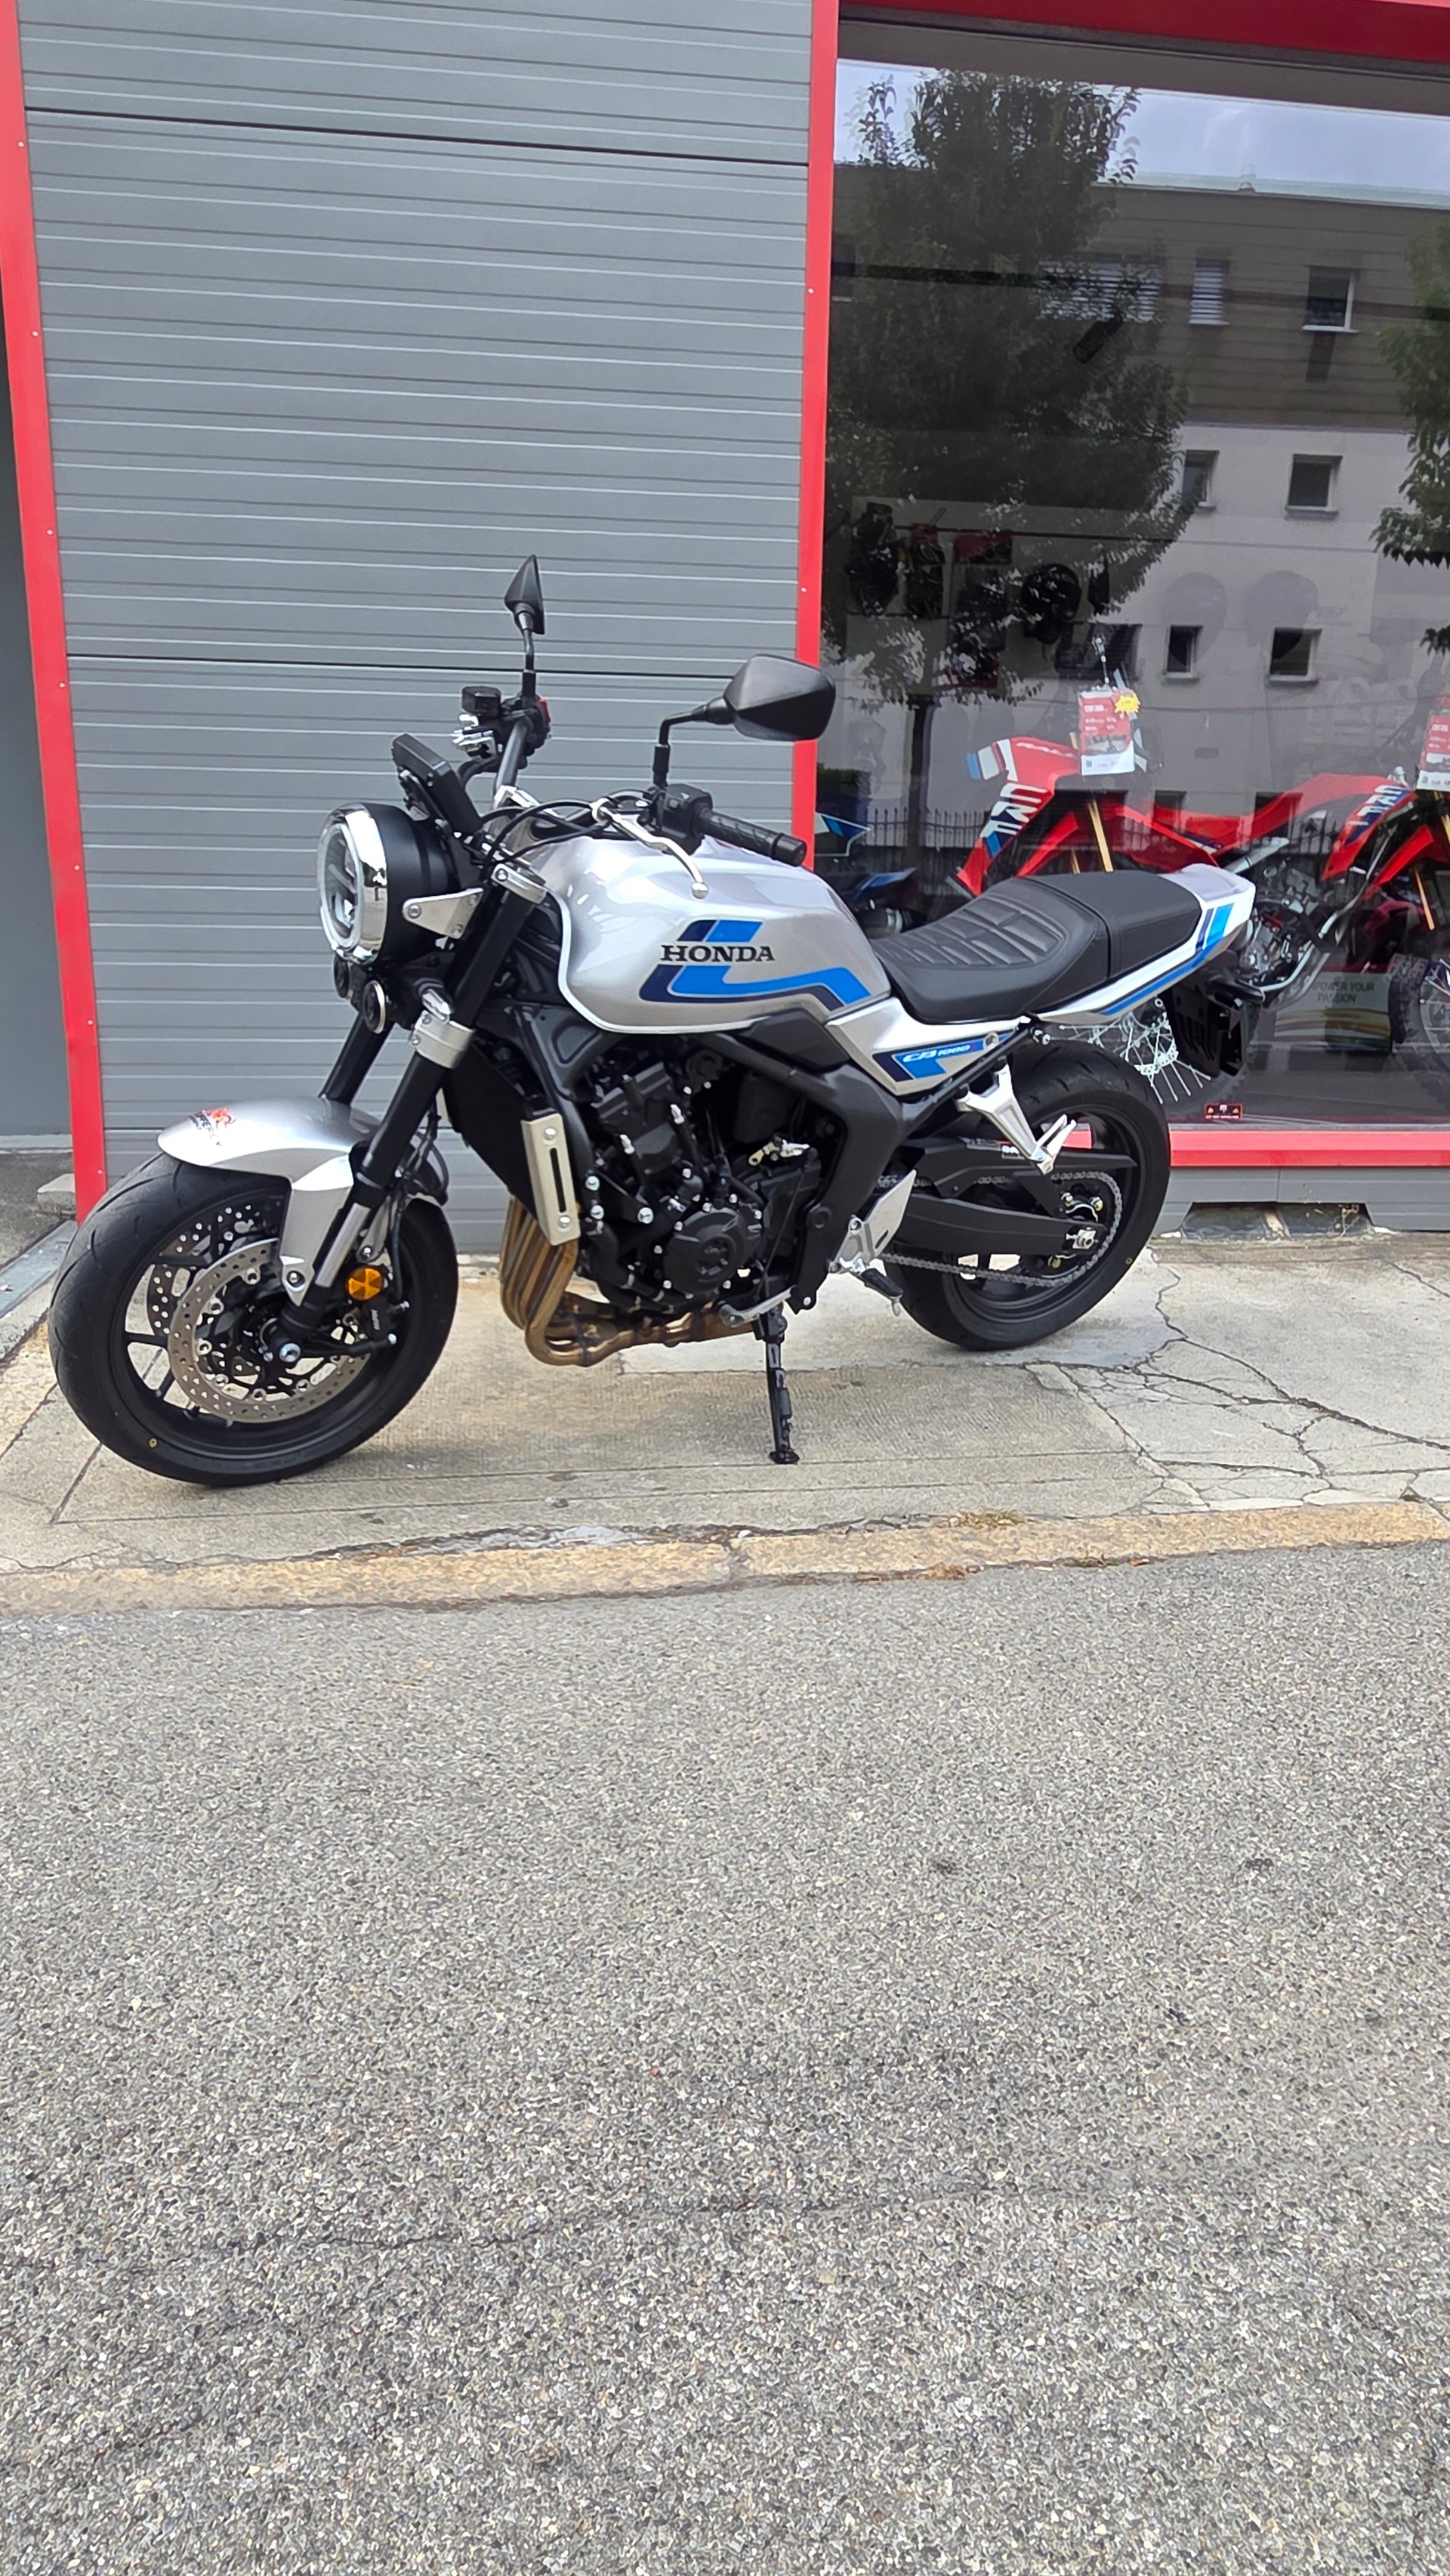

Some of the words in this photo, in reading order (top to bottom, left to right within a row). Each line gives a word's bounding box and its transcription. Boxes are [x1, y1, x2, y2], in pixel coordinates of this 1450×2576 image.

[980, 783, 1049, 838] CRF
[660, 944, 776, 962] HONDA
[1350, 983, 1375, 992] YOUR
[1317, 993, 1356, 1003] PASSION
[902, 1049, 936, 1062] CB
